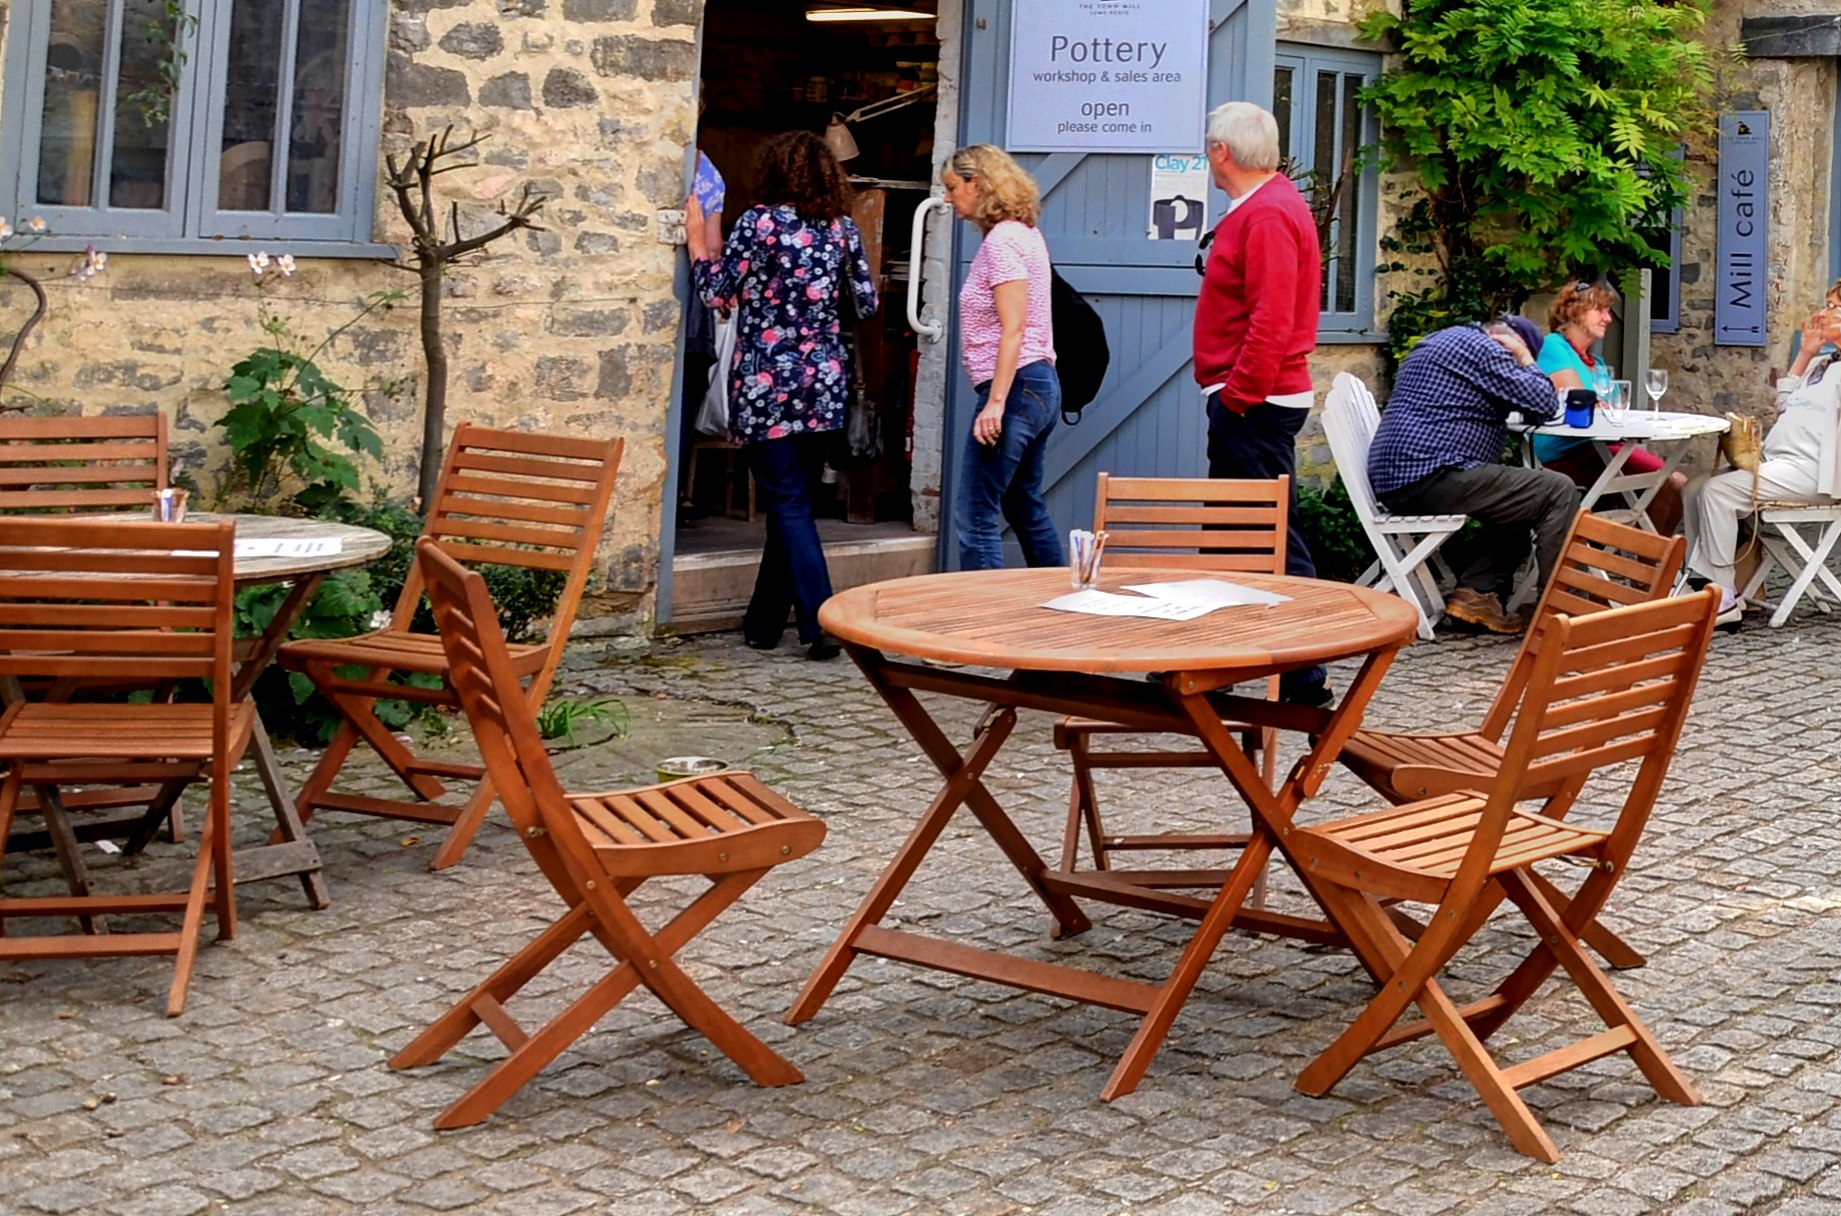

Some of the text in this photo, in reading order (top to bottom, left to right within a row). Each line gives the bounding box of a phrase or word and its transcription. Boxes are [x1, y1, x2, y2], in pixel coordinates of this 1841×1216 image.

[1050, 36, 1168, 69] Pottery
[1033, 70, 1182, 84] workshop & sales area
[1081, 102, 1130, 120] open
[1057, 120, 1152, 134] please come in
[1154, 154, 1190, 173] Clay
[1730, 169, 1754, 237] café
[1729, 253, 1752, 308] Mill
